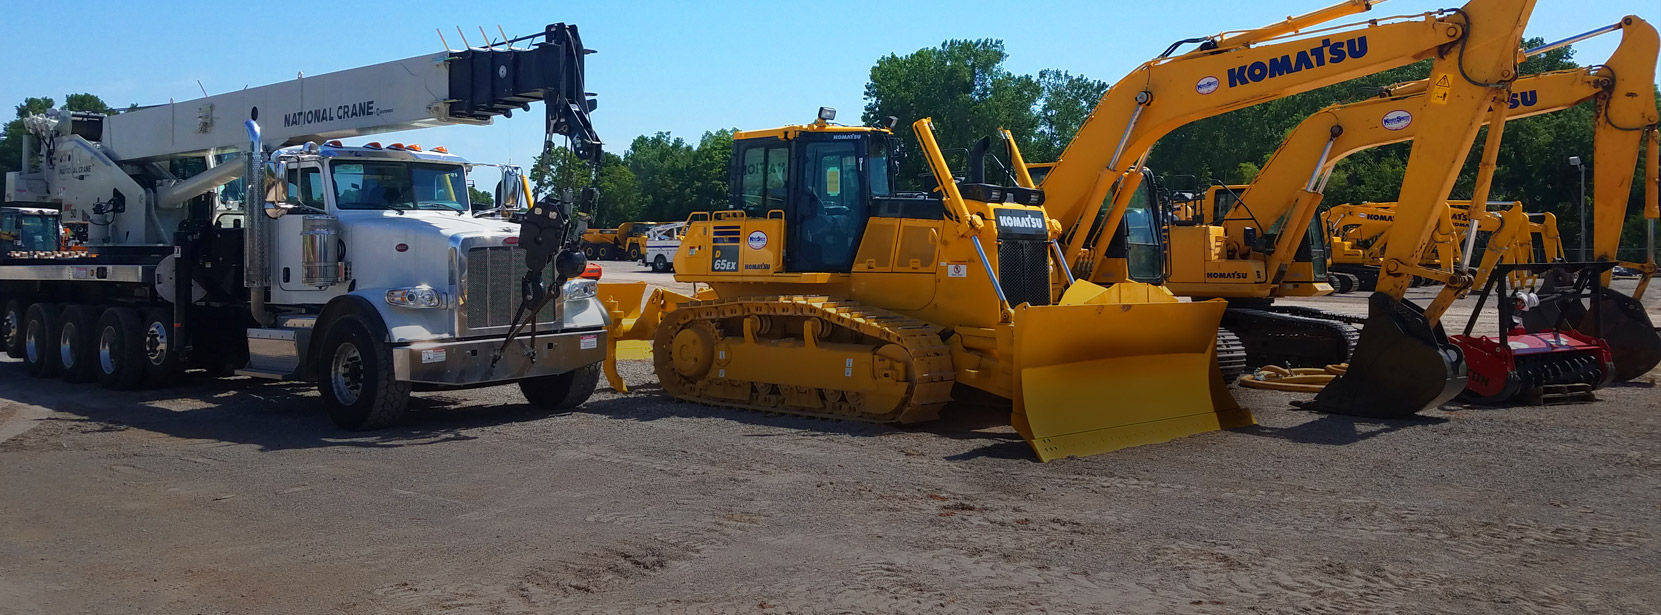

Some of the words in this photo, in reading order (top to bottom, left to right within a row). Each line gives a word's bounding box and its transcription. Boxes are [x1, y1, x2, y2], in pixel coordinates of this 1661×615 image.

[1227, 35, 1369, 88] KOMATSU
[284, 107, 334, 127] NATIONAL
[337, 100, 374, 119] CRANE
[999, 214, 1043, 229] KOMATSU
[1367, 213, 1395, 222] KOMA
[715, 250, 721, 258] D
[714, 259, 737, 270] 65EX
[745, 262, 770, 270] KOMATSU
[1206, 271, 1248, 279] KOMATSU
